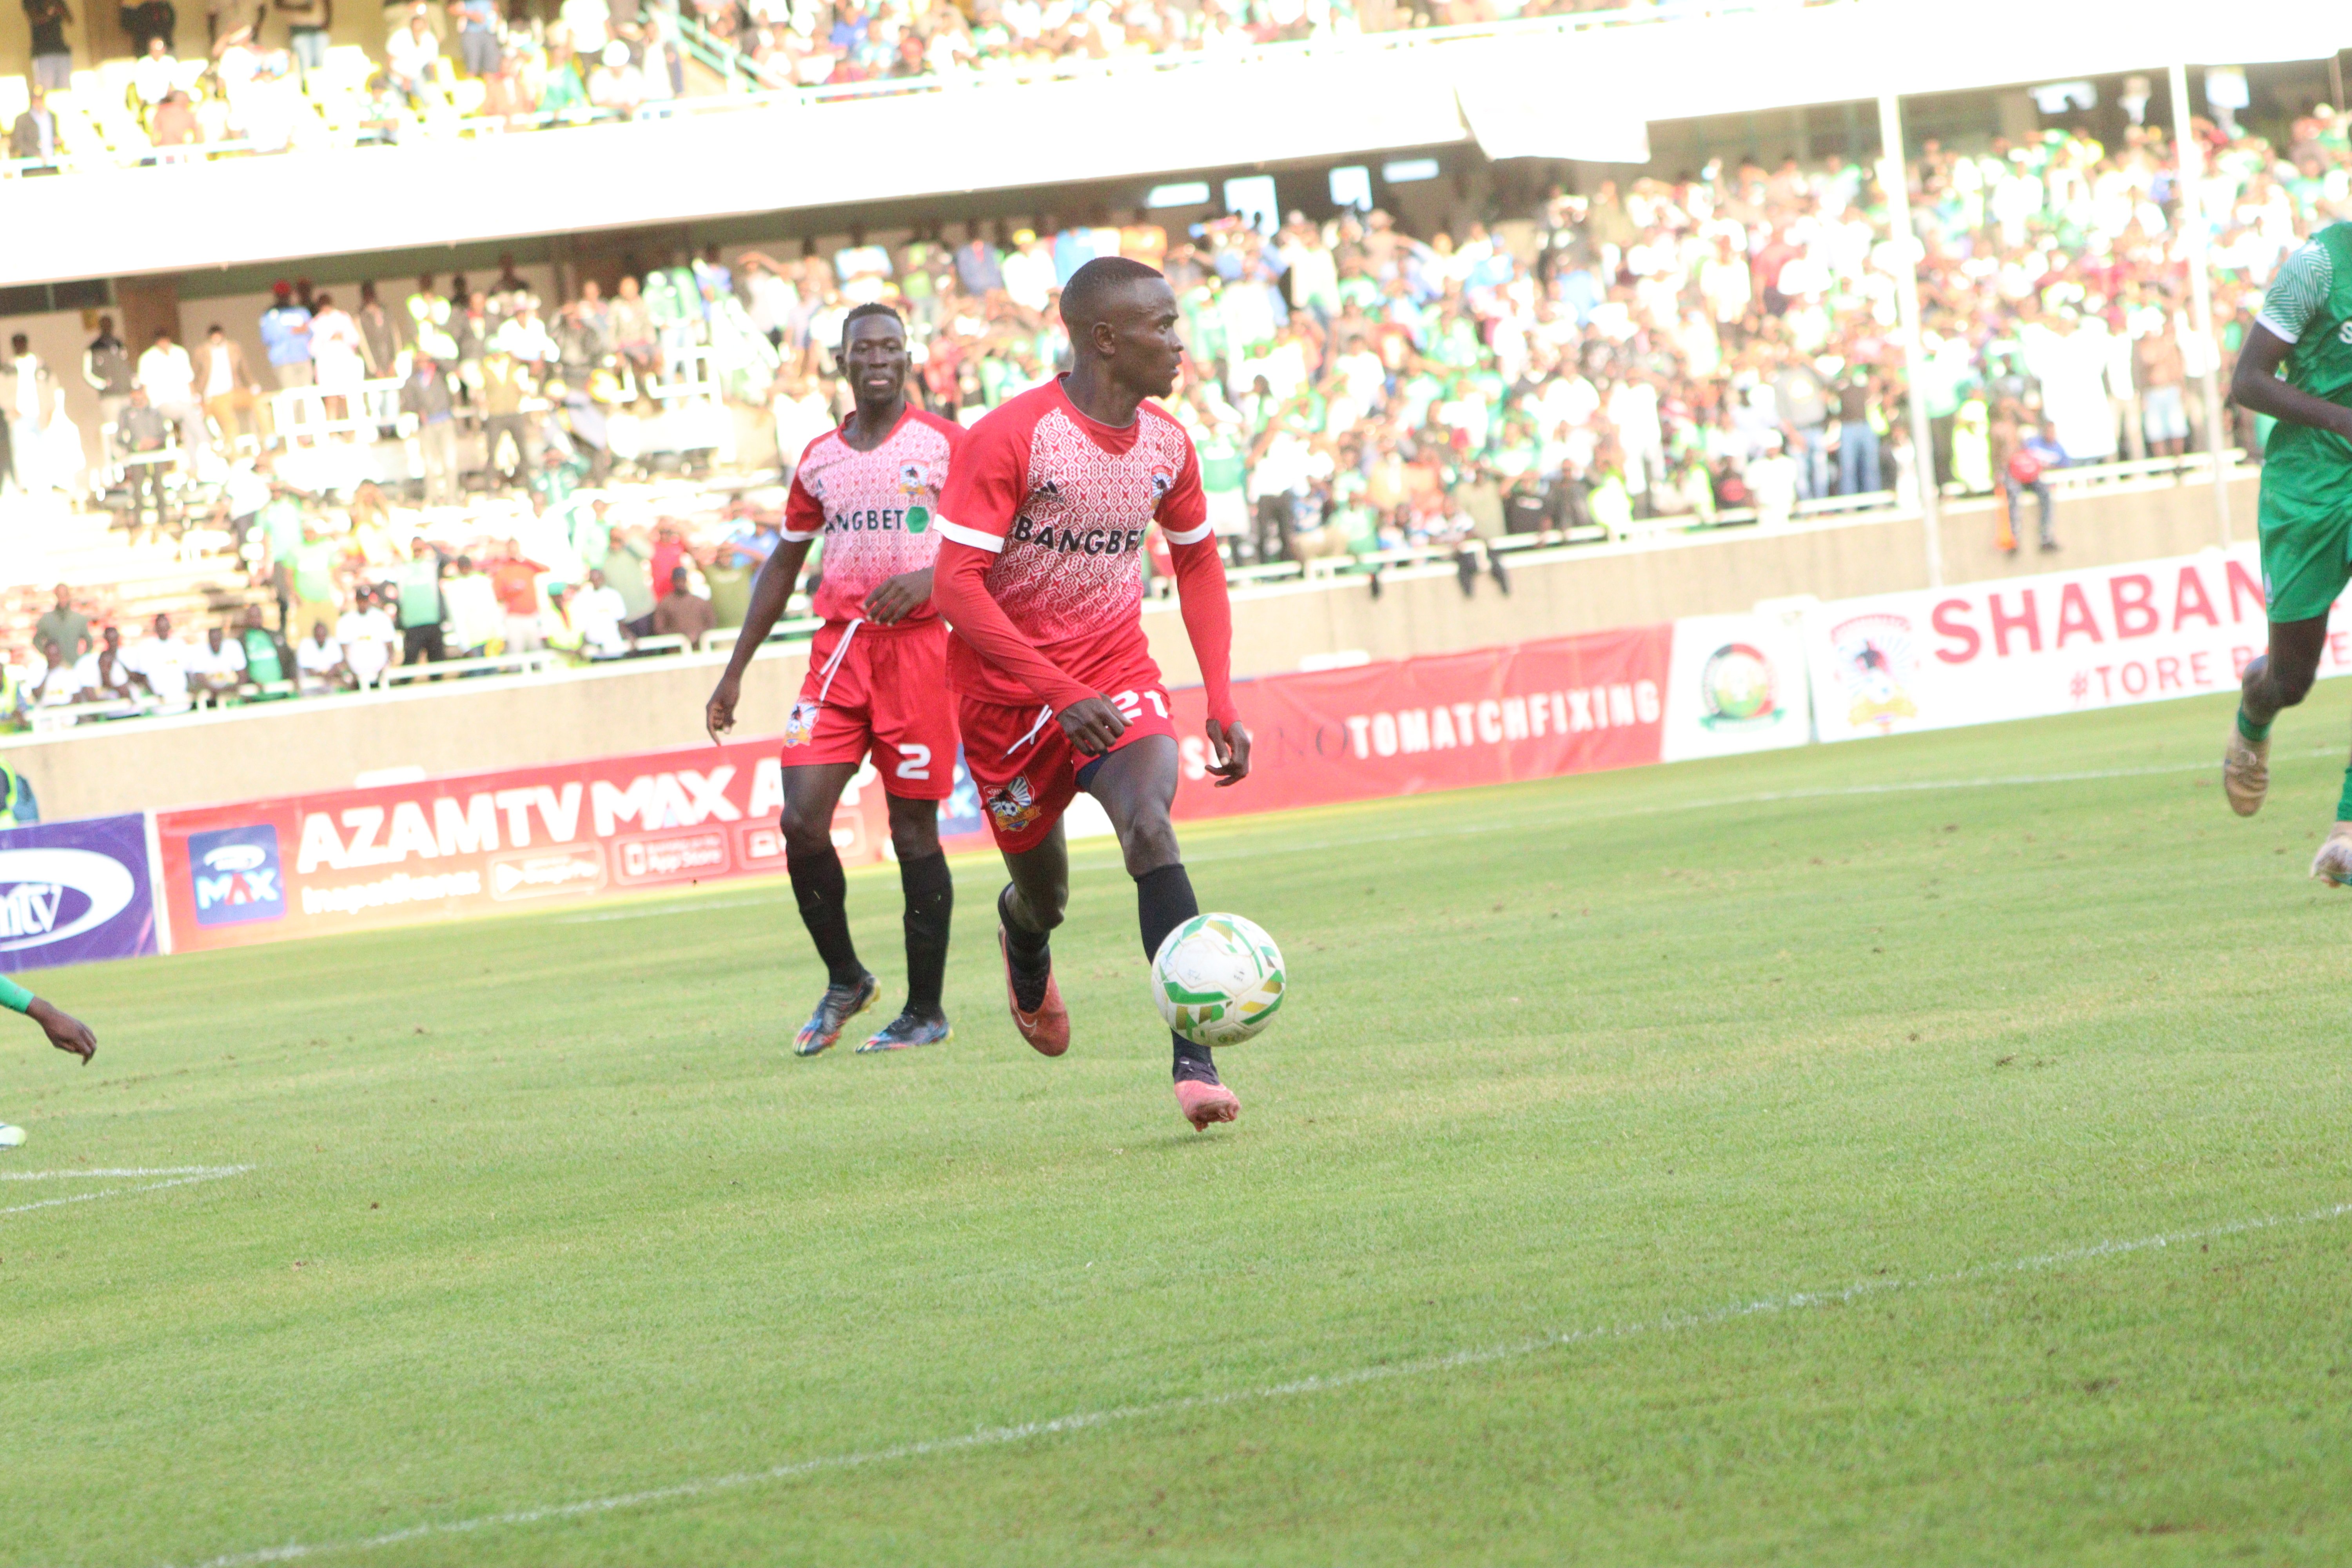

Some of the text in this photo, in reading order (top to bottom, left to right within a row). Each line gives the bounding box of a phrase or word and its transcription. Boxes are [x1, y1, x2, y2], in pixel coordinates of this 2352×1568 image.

[824, 509, 904, 534] ANGBET
[1014, 515, 1145, 555] BANGBE
[1111, 689, 1169, 720] 21
[896, 743, 931, 780] 2
[590, 764, 741, 837] MAX
[195, 867, 280, 909] MAX
